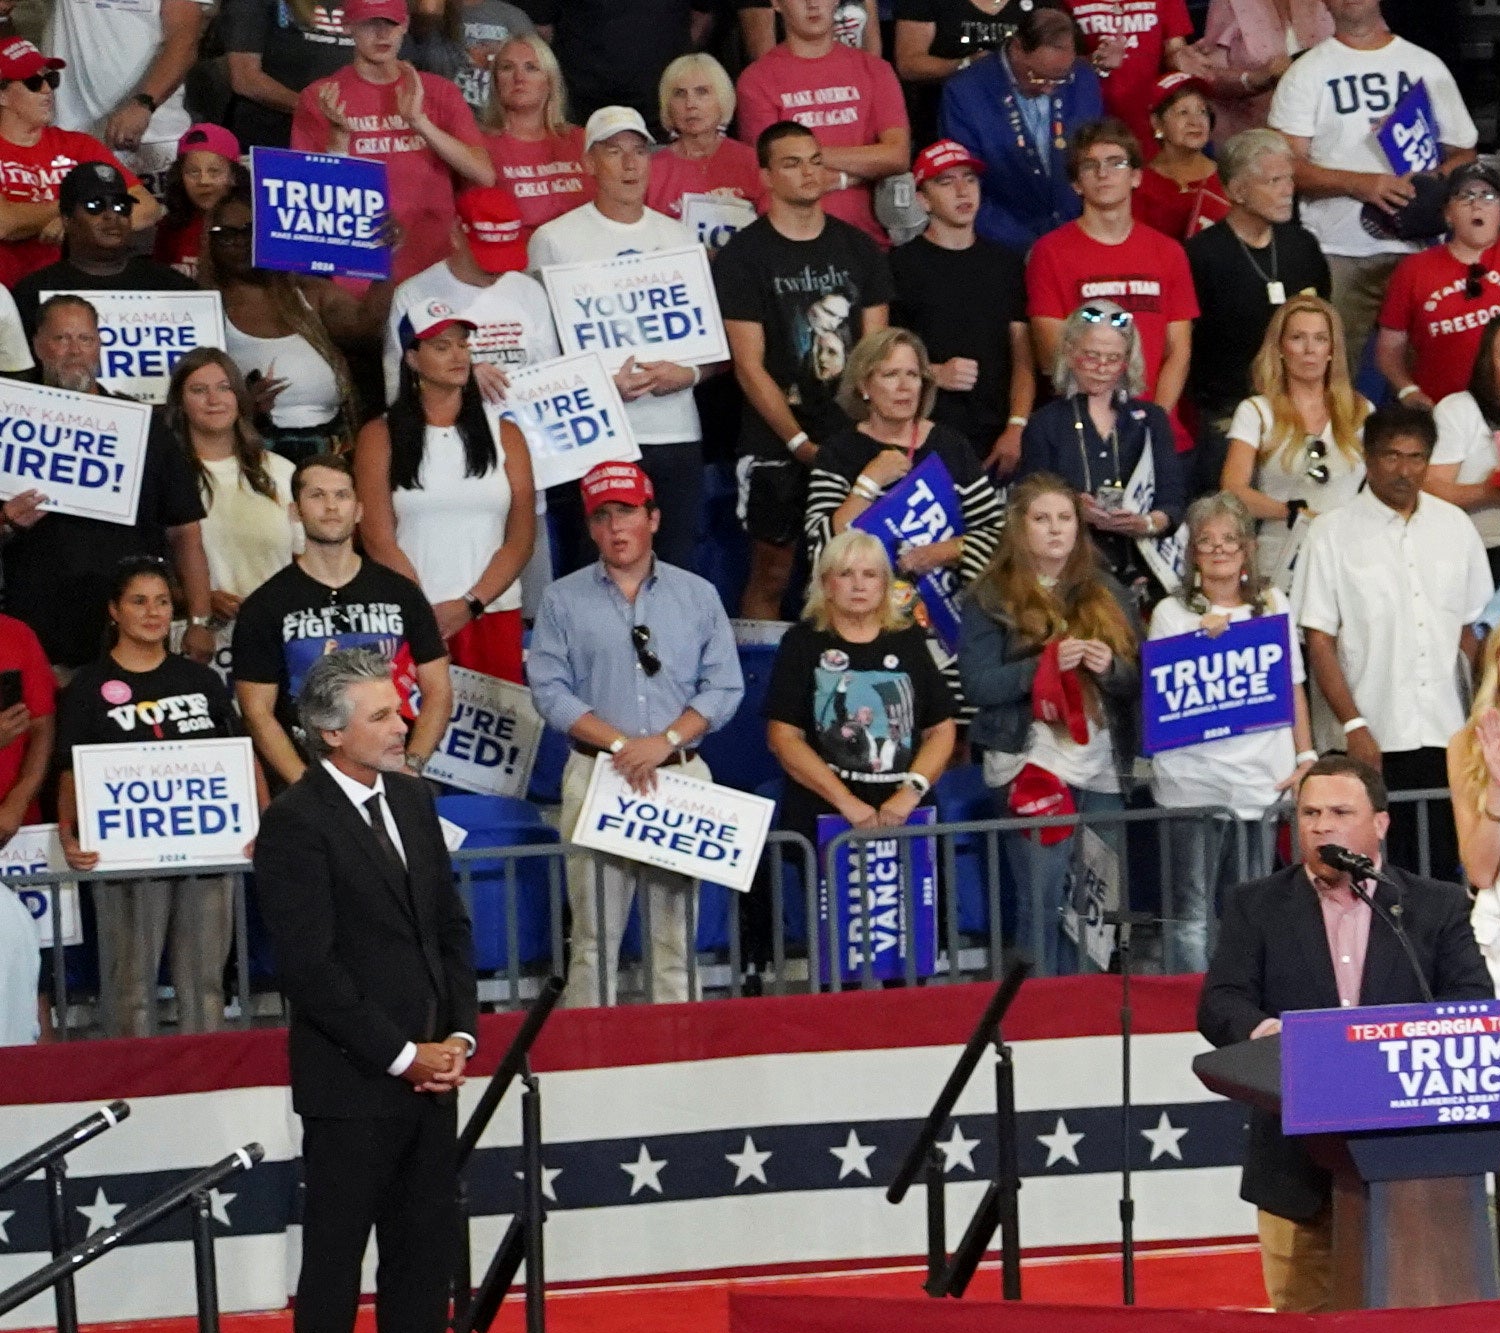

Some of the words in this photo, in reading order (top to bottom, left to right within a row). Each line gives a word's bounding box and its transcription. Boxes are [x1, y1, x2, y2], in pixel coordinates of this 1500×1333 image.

[1077, 14, 1159, 35] TRUMP
[1328, 70, 1415, 115] USA
[355, 138, 391, 153] GREAT
[263, 178, 385, 216] TRUMP
[514, 180, 549, 198] GREAT
[277, 208, 372, 240] VANCE
[613, 270, 682, 290] KAMALA
[1128, 281, 1160, 296] TEAM
[575, 284, 690, 318] YOU'RE
[119, 311, 194, 324] KAMALA
[575, 307, 706, 349] FIRED!
[41, 409, 118, 433] KAMALA
[0, 416, 118, 457] YOU'RE
[2, 441, 125, 493] IRED!
[368, 603, 401, 615] STOP
[1151, 643, 1283, 698] TRUMP
[457, 690, 517, 716] AMALA
[1163, 673, 1268, 713] VANCE
[150, 761, 226, 777] KAMALA
[105, 778, 229, 805] YOU'RE
[98, 803, 242, 841] FIRED!
[616, 797, 739, 843] YOU'RE
[596, 814, 743, 868] FIRED!
[872, 838, 898, 957] VANCE
[1352, 1022, 1397, 1041] TEXT
[1402, 1014, 1485, 1038] GEORGIA
[1390, 1098, 1418, 1109] MAKE
[1421, 1095, 1465, 1107] AMERICA
[1468, 1092, 1500, 1104] GREAT
[1438, 1105, 1490, 1122] 2024
